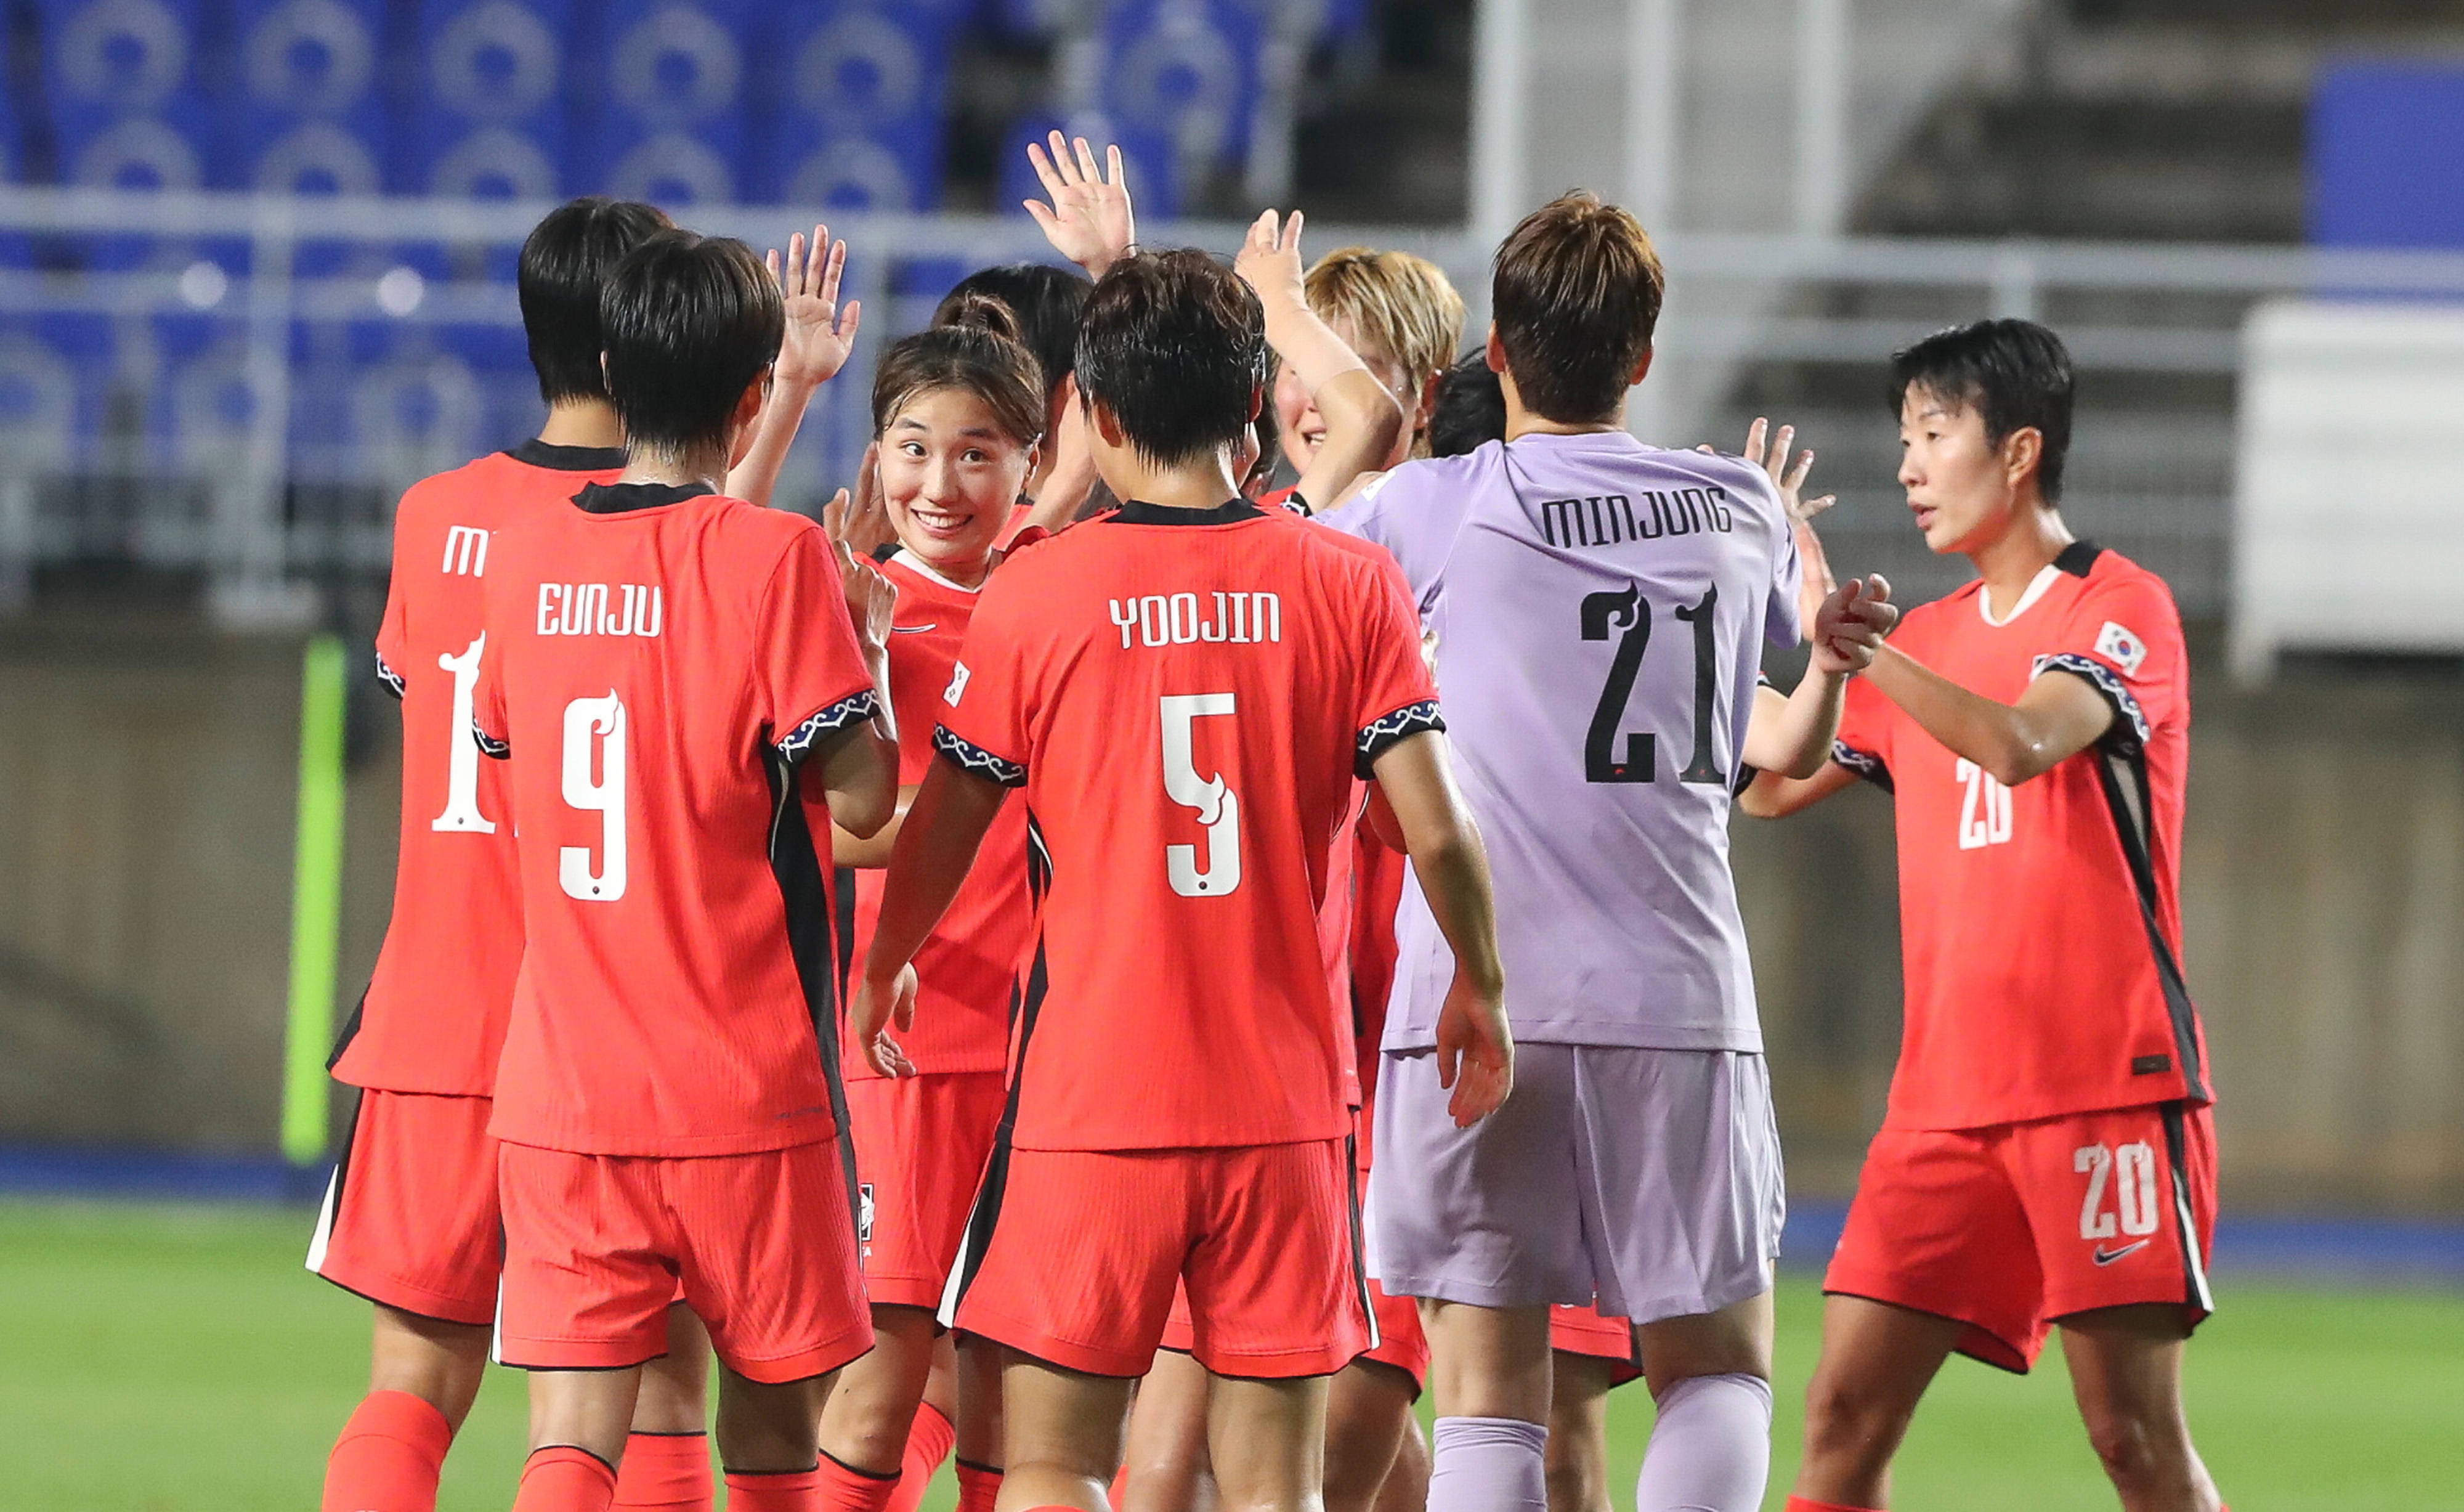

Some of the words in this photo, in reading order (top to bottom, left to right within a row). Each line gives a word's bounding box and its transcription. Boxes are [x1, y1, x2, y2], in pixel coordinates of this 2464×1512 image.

[442, 525, 497, 578] M
[1542, 487, 1732, 548] MINJUNG
[537, 583, 662, 637] EUNJU
[1109, 591, 1281, 649] YOOJIN
[1581, 580, 1725, 782] 21
[431, 628, 519, 838] 1
[559, 687, 627, 901] 9
[1160, 693, 1241, 897] 5
[1956, 757, 2014, 850] 20
[2074, 1140, 2160, 1240] 20
